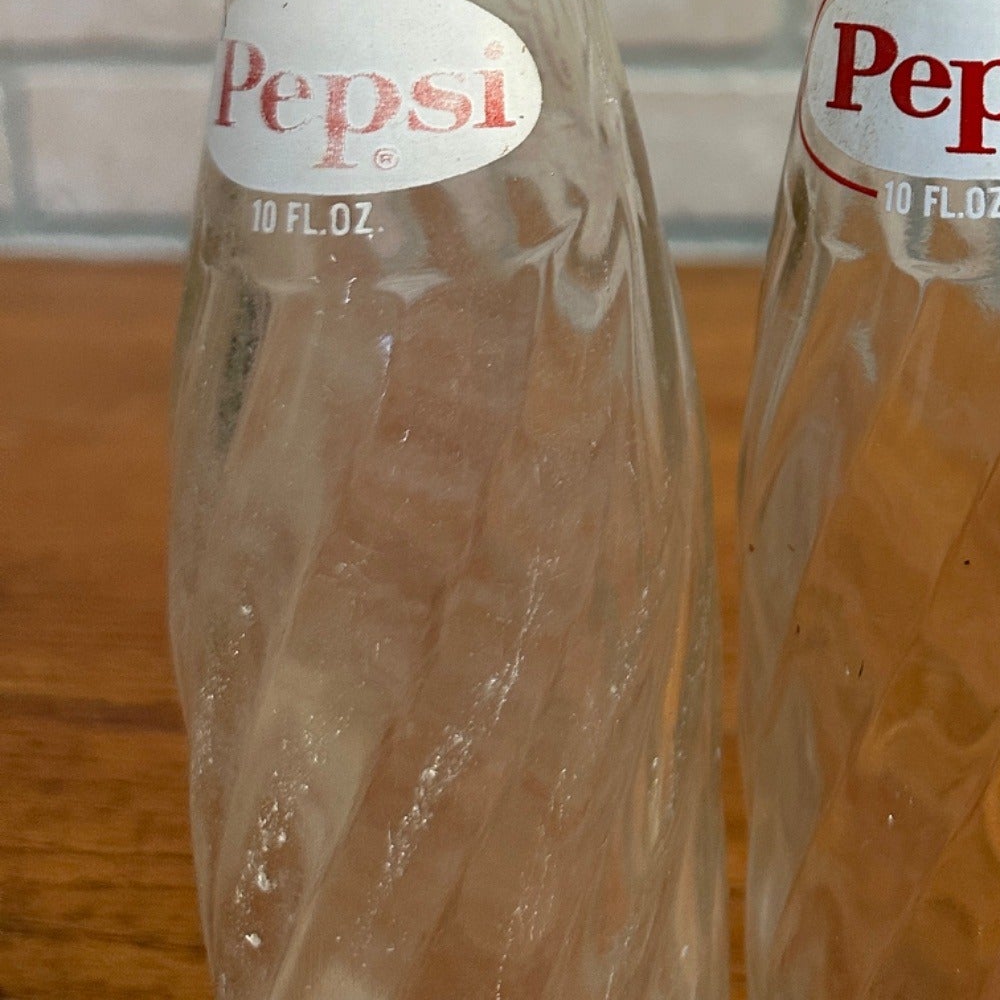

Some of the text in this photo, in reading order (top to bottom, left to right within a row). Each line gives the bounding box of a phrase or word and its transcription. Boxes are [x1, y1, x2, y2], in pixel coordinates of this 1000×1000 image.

[214, 38, 517, 169] Pepsi
[884, 180, 912, 215] 10
[252, 199, 278, 234] 10
